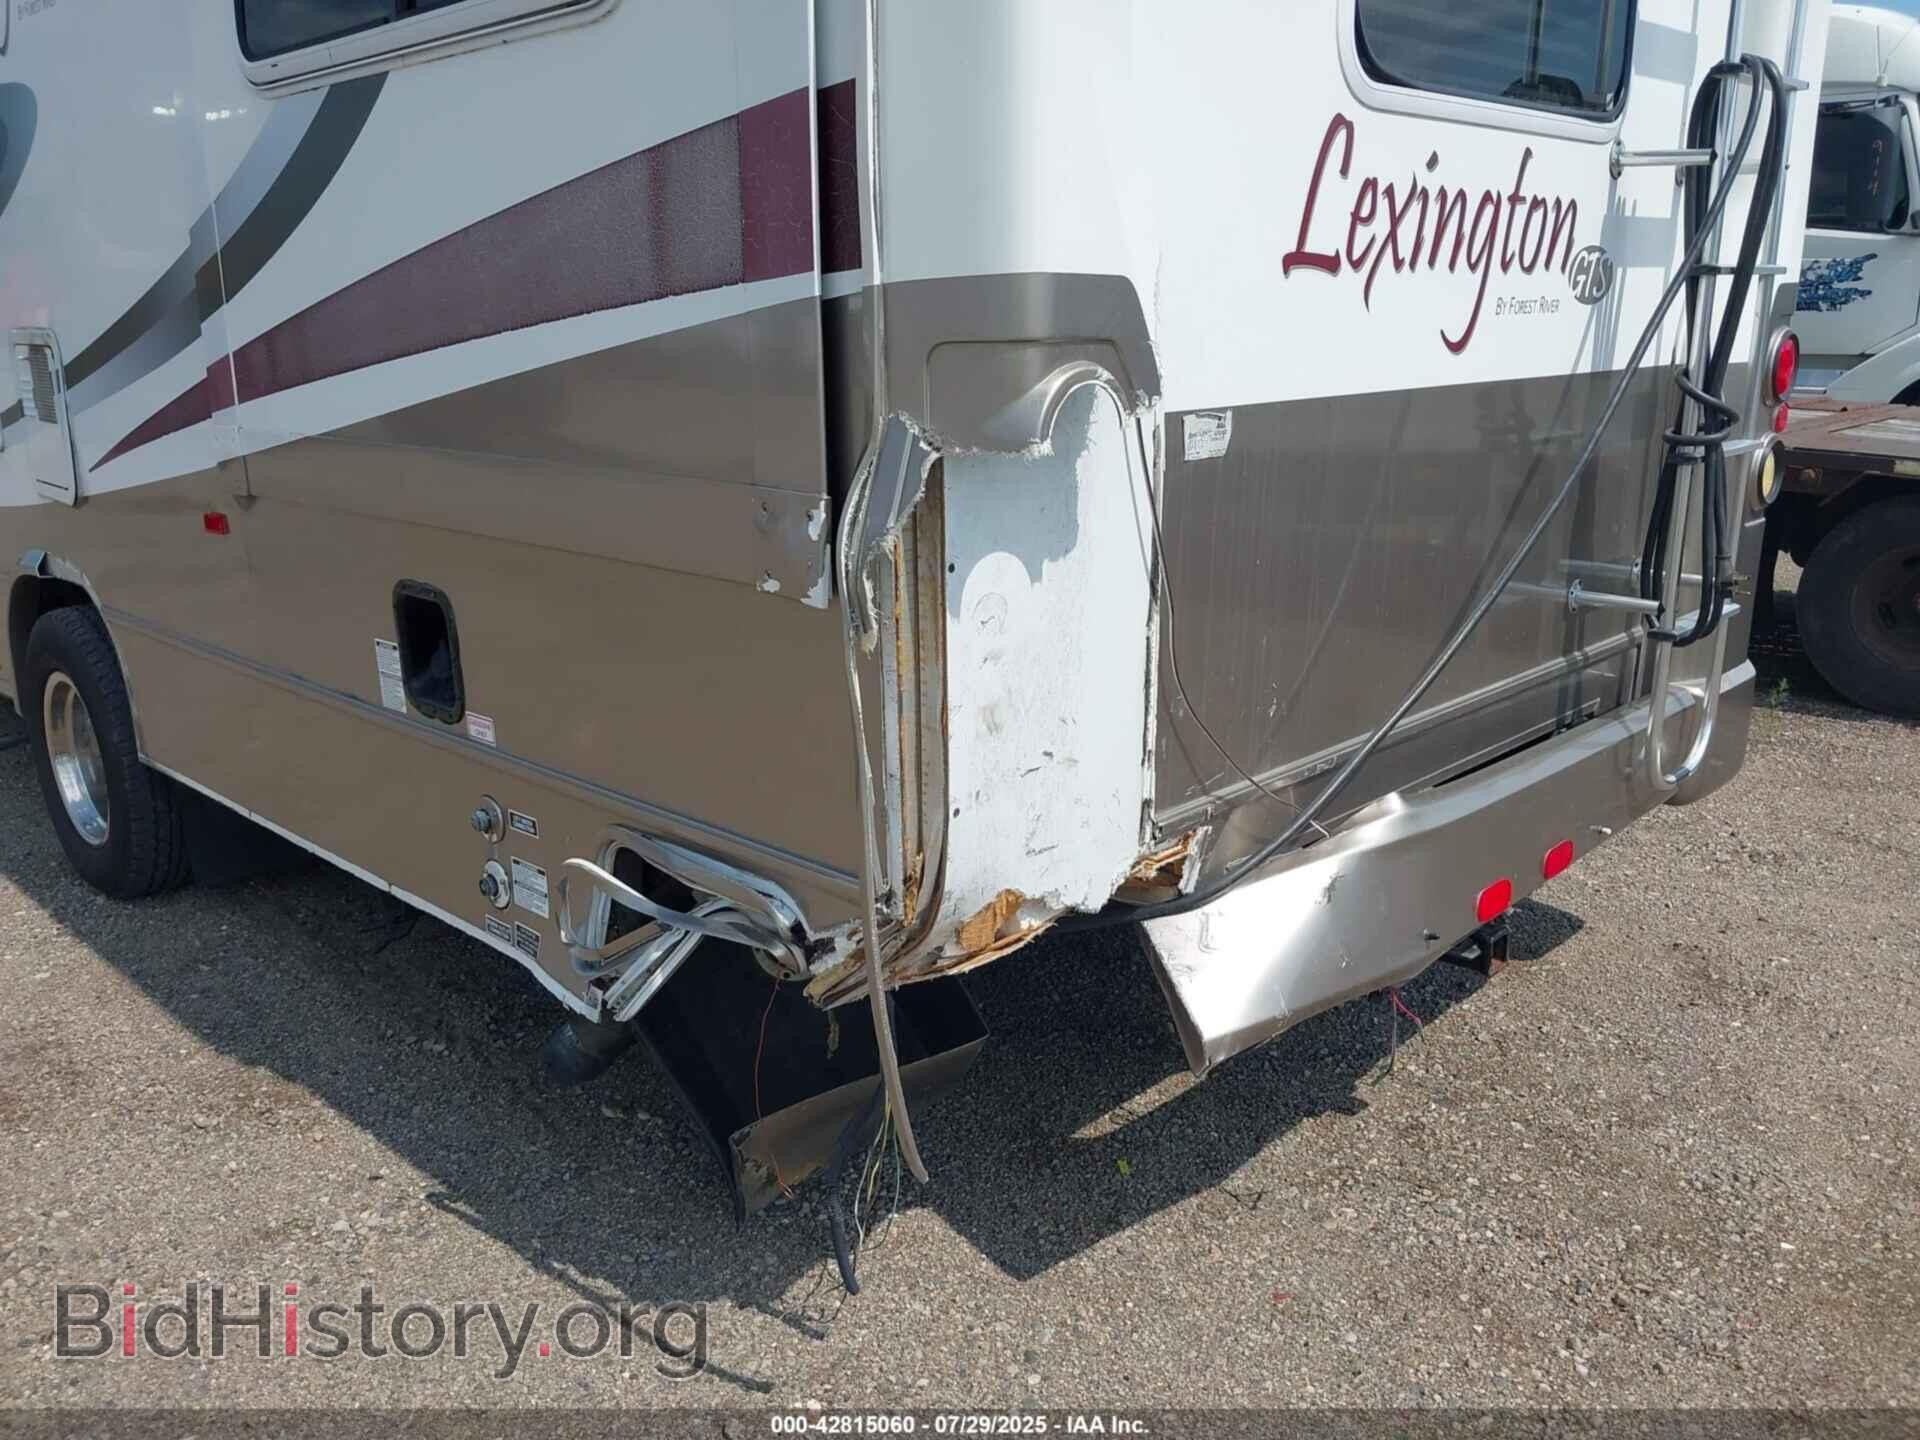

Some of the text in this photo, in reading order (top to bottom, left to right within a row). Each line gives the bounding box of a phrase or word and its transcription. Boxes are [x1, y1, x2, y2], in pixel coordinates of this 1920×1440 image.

[1282, 112, 1578, 354] Lexington
[1569, 248, 1612, 299] GTS
[1508, 296, 1538, 315] FOREST
